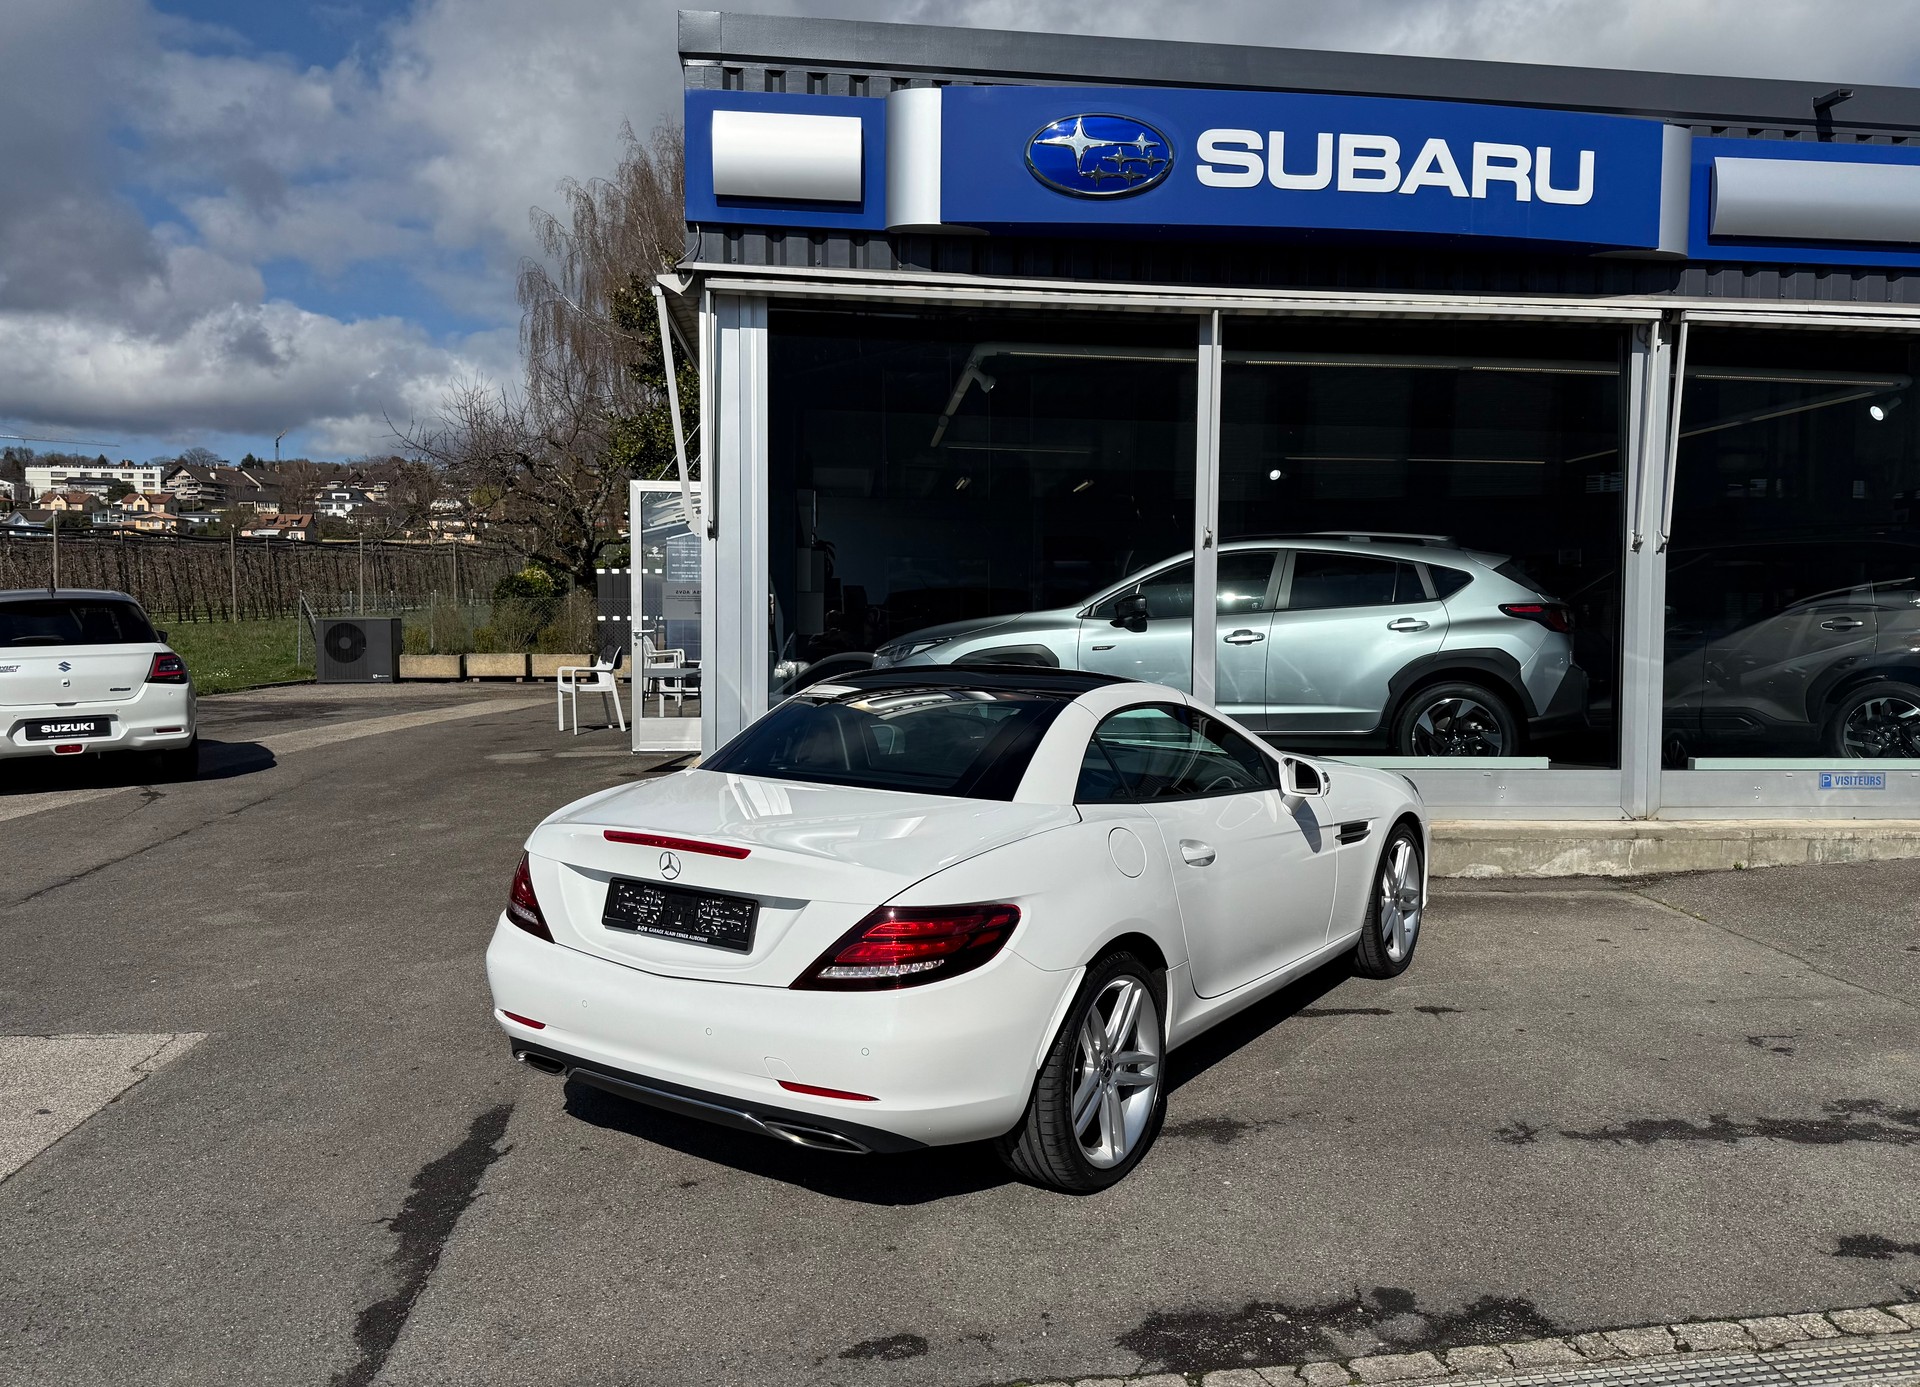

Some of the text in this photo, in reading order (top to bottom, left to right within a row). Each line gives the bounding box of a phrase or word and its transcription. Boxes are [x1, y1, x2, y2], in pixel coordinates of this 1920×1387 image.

[1196, 128, 1595, 205] SUBARU
[41, 722, 95, 733] SUZUKI
[1834, 775, 1881, 786] VISITEURS
[648, 926, 664, 935] GARAGE
